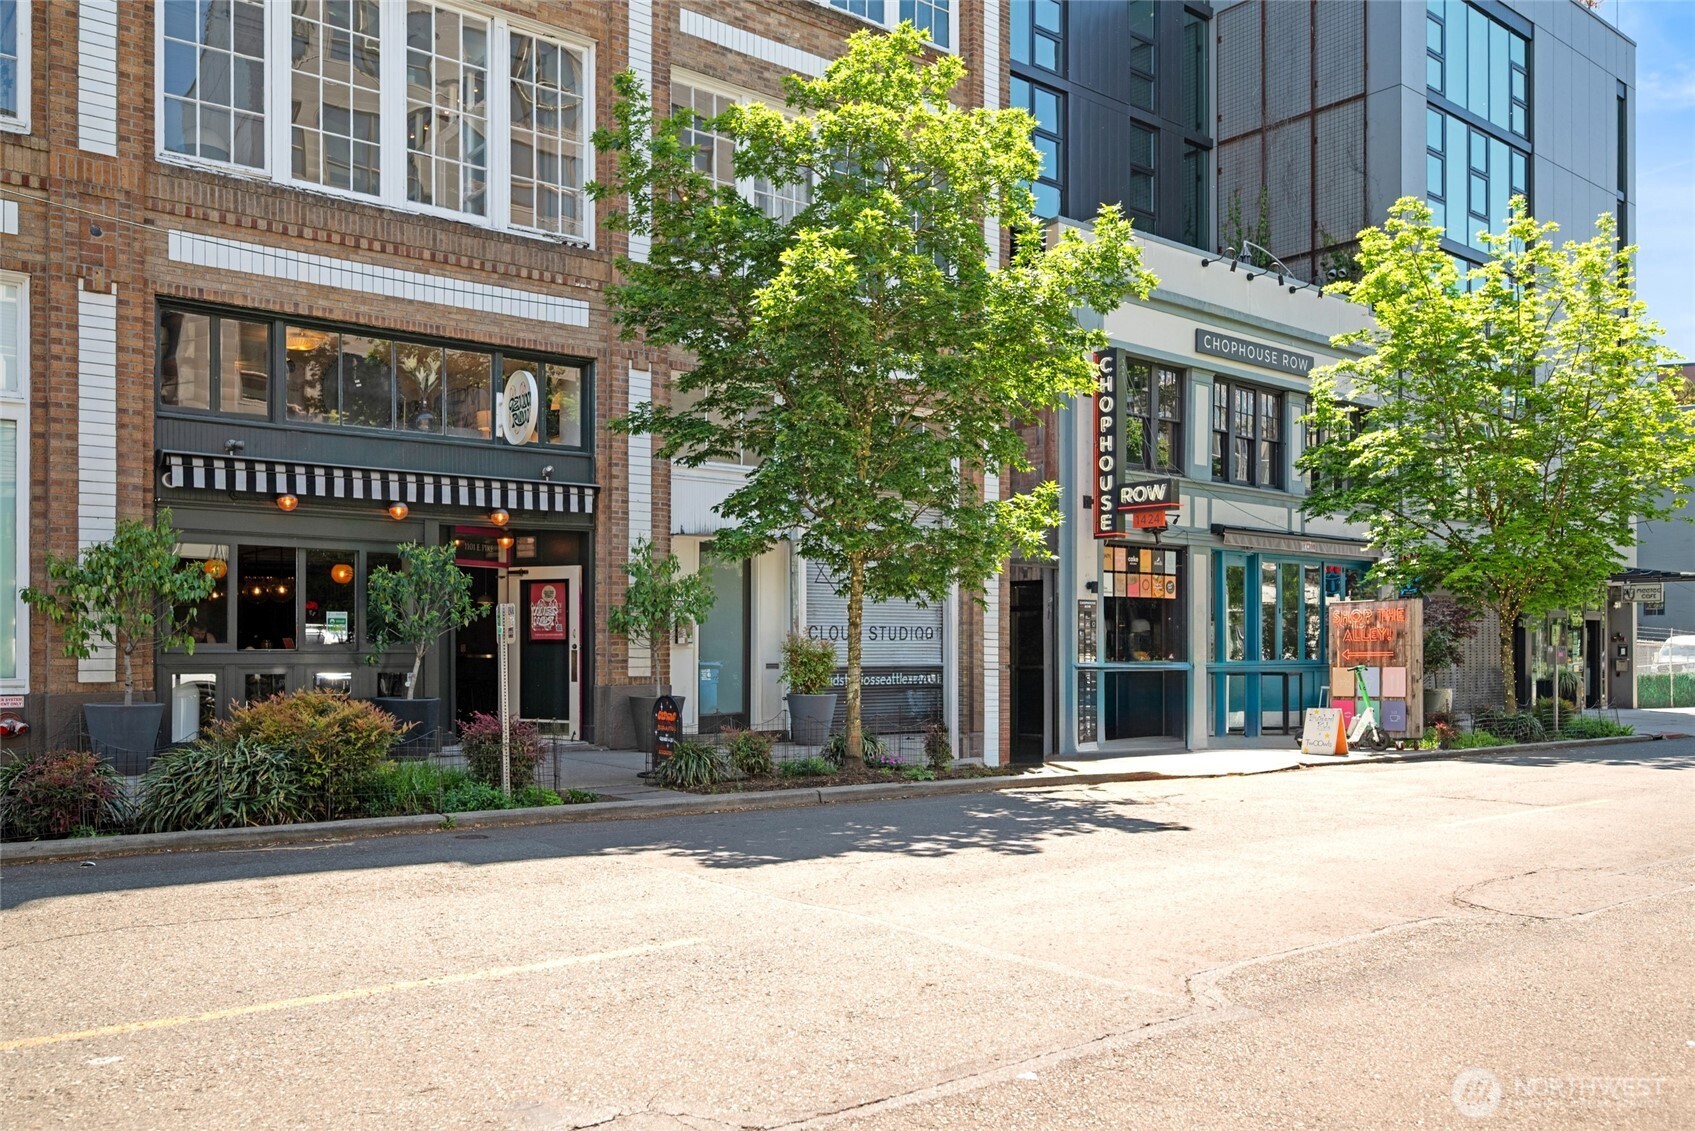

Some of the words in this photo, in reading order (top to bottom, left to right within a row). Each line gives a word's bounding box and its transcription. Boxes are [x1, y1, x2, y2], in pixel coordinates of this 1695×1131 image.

[1203, 335, 1278, 365] CHOPHOUSE
[1282, 353, 1309, 371] ROW
[1098, 356, 1114, 531] CHOPHOUSE
[1120, 483, 1168, 504] ROW
[1135, 513, 1161, 526] 1424
[1332, 608, 1373, 624] SHOP
[1377, 607, 1406, 622] THE
[808, 625, 858, 641] CLOU
[1343, 627, 1393, 642] ALLEY!
